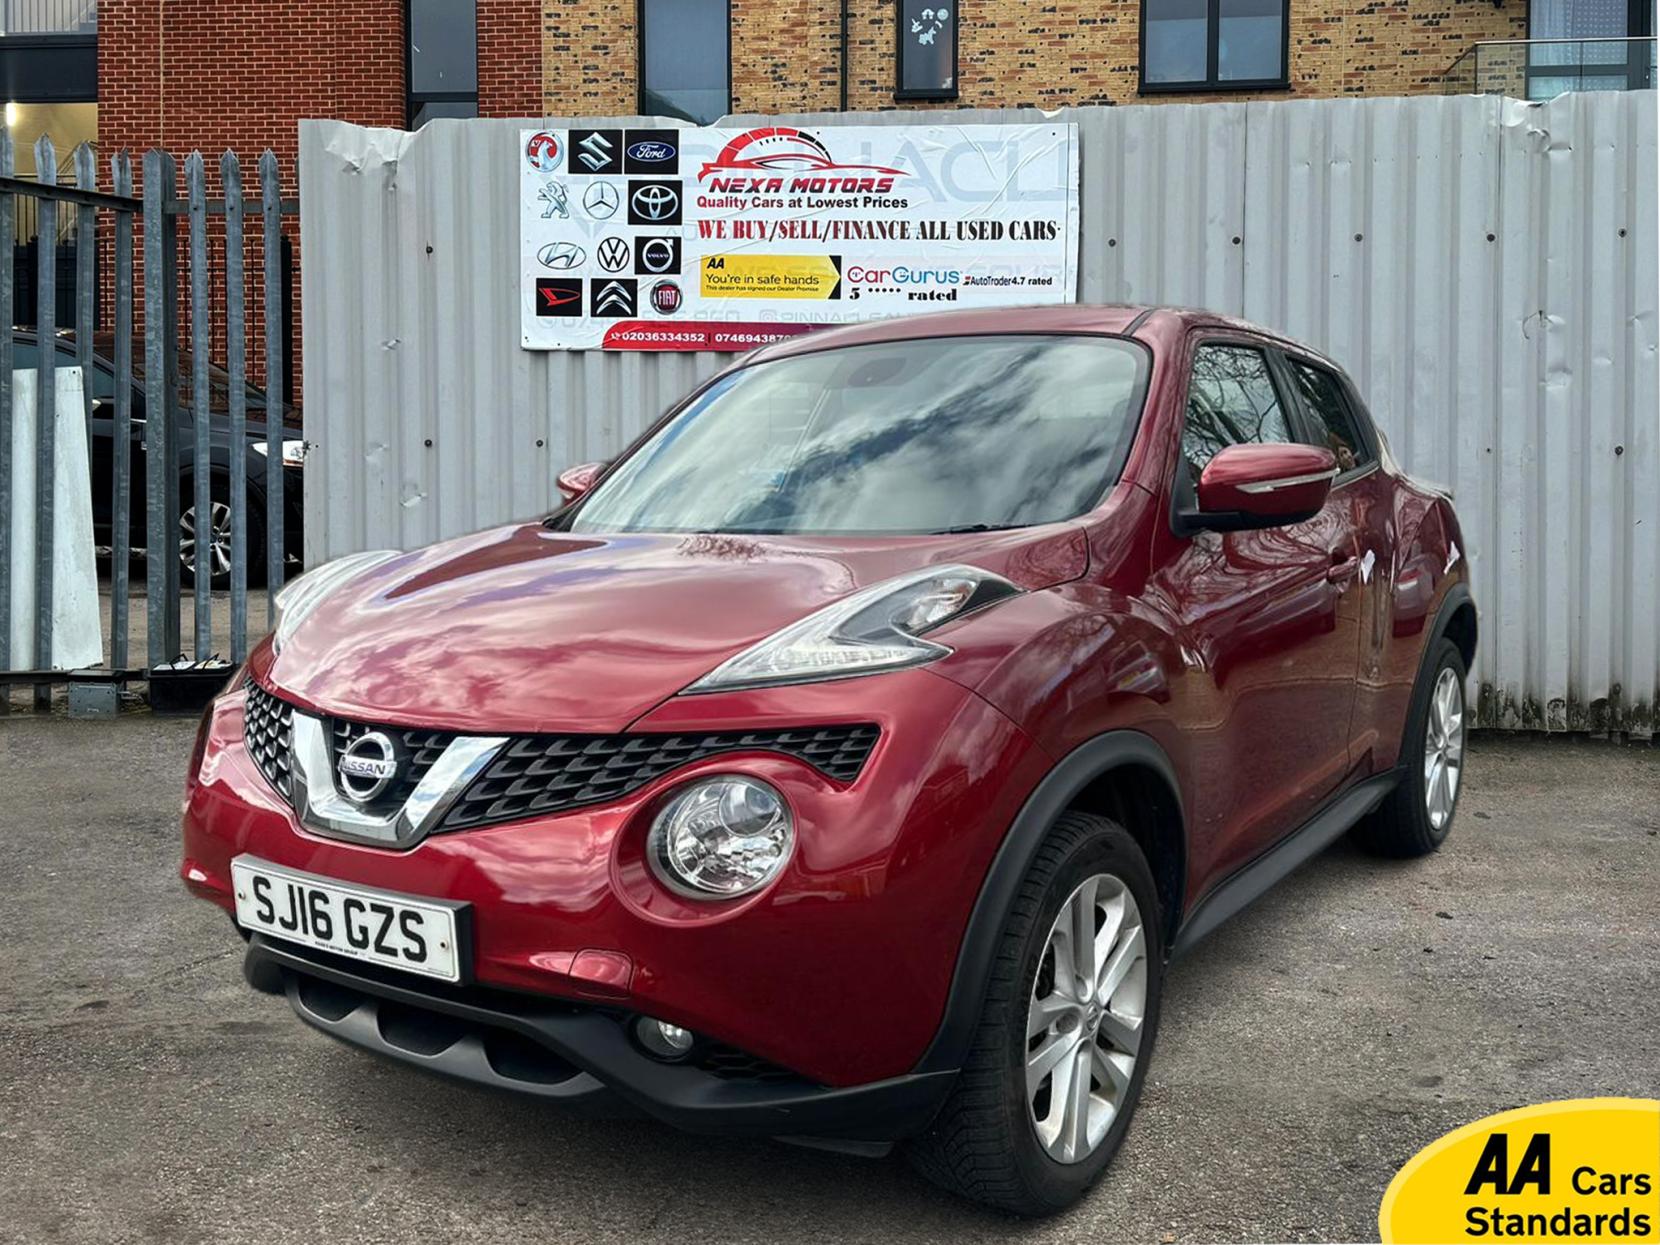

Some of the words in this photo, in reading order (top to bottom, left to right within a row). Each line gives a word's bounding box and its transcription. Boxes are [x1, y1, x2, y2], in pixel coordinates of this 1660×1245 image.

[636, 144, 666, 159] Ford
[709, 178, 784, 193] NEXA
[789, 178, 894, 193] MOTORS
[697, 196, 747, 210] Quality
[752, 196, 784, 208] Cars
[788, 197, 803, 208] at
[808, 196, 858, 208] Lowest
[863, 196, 908, 208] Prices
[698, 220, 727, 239] WE
[733, 219, 911, 242] BUY/SELL/FINANCE
[916, 220, 951, 240] ALL
[957, 220, 1004, 240] USED
[1009, 220, 1057, 240] CARS
[706, 257, 725, 269] AA
[706, 274, 741, 284] You're
[744, 274, 754, 284] in
[757, 274, 781, 285] safe
[784, 274, 820, 285] hands
[847, 266, 960, 284] CarGurus
[1028, 276, 1053, 286] rated
[658, 290, 676, 306] FIAT
[849, 287, 861, 300] 5
[908, 288, 957, 301] rated
[622, 331, 705, 342] 02036334352
[341, 754, 387, 775] NISSAN
[252, 875, 333, 941] SJ16
[343, 897, 428, 963] GZS
